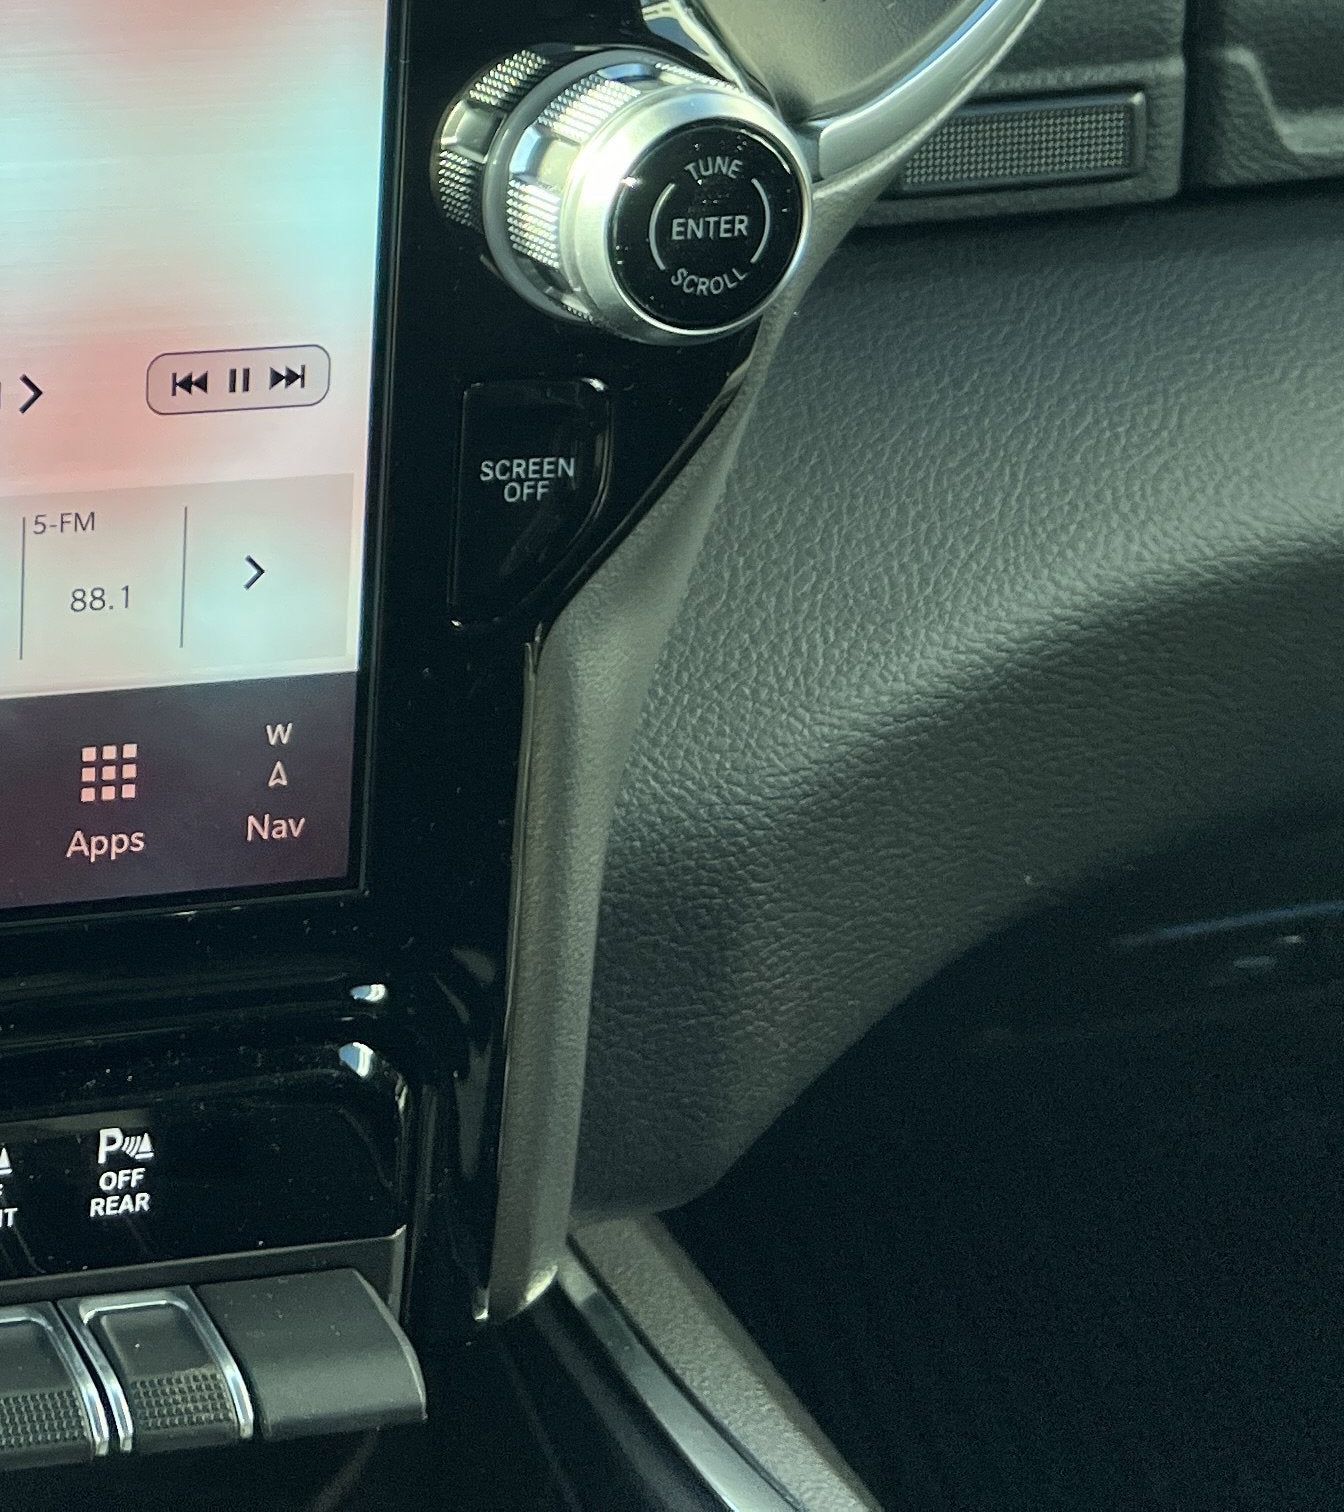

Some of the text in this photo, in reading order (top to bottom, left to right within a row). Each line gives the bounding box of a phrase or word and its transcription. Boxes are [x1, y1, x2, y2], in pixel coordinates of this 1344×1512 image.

[684, 155, 744, 181] TUNE
[670, 215, 749, 241] ENTER
[670, 267, 749, 297] SCROLL
[480, 456, 576, 483] SCREEN
[503, 480, 550, 504] OFF
[32, 510, 97, 536] 5-FM
[69, 585, 132, 612] 88.1
[265, 723, 293, 746] W
[246, 814, 306, 843] Nav
[66, 826, 146, 863] Apps
[98, 1167, 146, 1192] OFF
[90, 1192, 151, 1218] REAR
